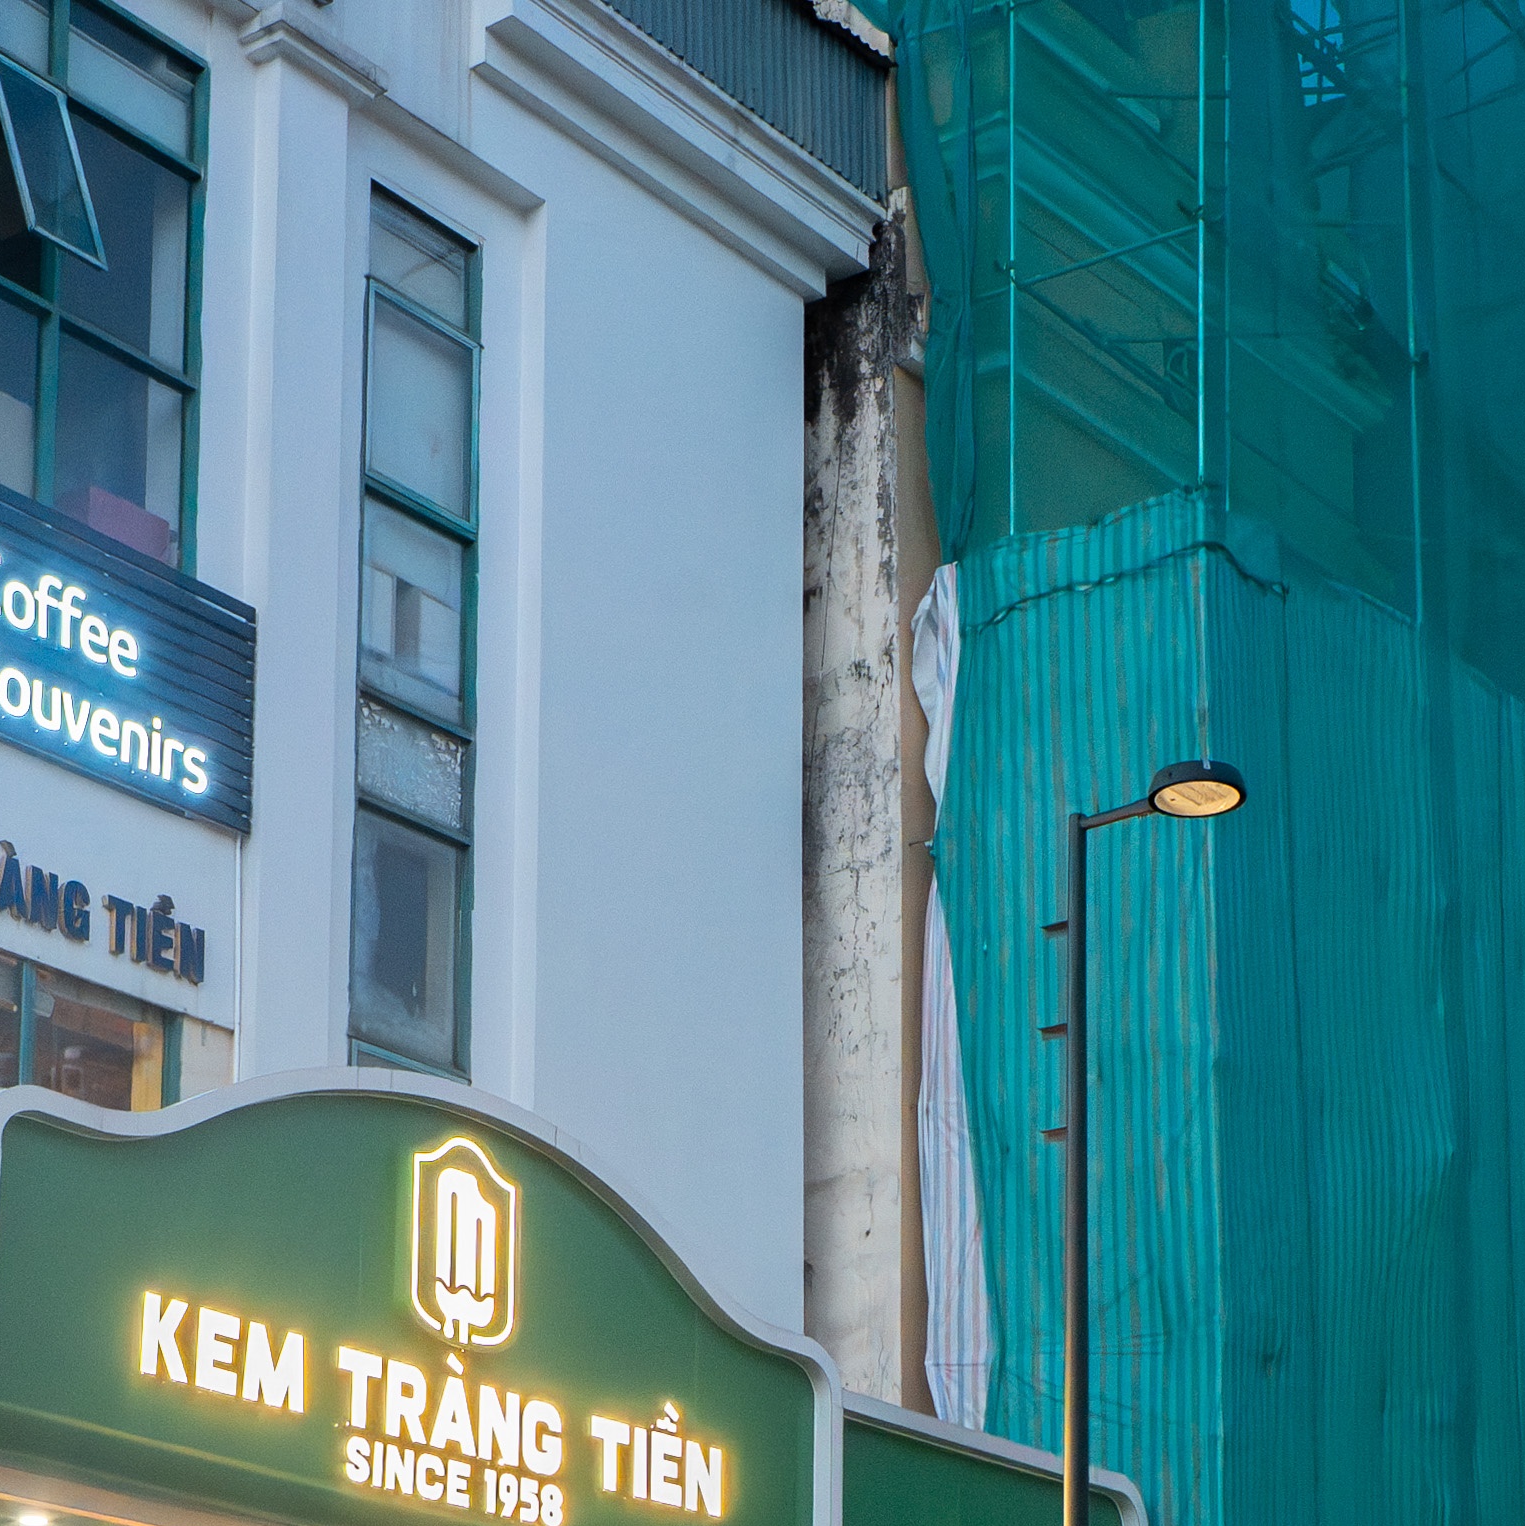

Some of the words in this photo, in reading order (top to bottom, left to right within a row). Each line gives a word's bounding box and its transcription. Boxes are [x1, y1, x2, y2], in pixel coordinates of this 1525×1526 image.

[102, 894, 206, 985] TIỀN
[138, 1290, 305, 1414] KEM
[337, 1346, 563, 1476] TRÀNG
[590, 1402, 724, 1519] TIỀN
[345, 1435, 471, 1508] SINCE
